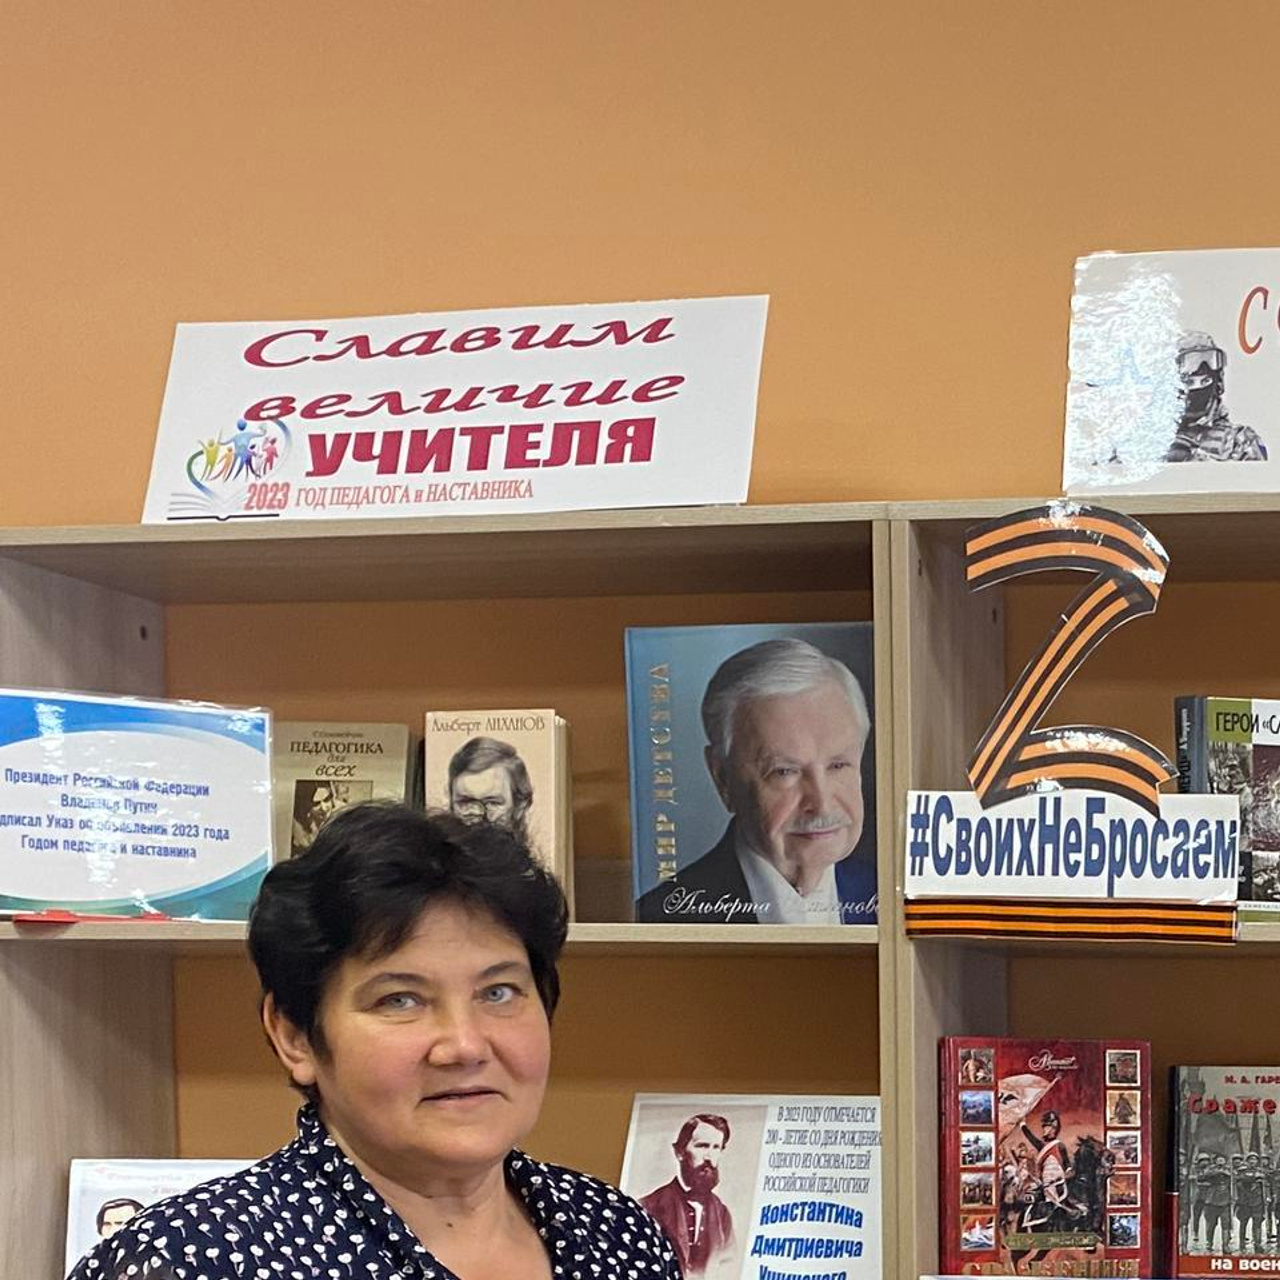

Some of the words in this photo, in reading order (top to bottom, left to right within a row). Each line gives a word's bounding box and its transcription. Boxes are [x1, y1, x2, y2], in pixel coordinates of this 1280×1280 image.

[1237, 286, 1269, 355] С
[244, 317, 675, 369] Славим
[244, 374, 685, 422] величие
[305, 417, 657, 478] УЧИТЕЛЯ
[244, 483, 289, 511] 2023
[295, 487, 327, 508] ГОД
[329, 484, 410, 505] ПЕДАГОГА
[414, 489, 425, 502] и
[427, 479, 534, 501] НАСТАВНИКА
[432, 715, 481, 736] Альберт
[485, 715, 546, 732] ЛИХАНОВ
[1216, 711, 1259, 733] ГЕРОИ
[290, 741, 384, 755] ПЕДАГОГИКА
[5, 768, 67, 786] Президент
[315, 765, 357, 777] всех
[0, 814, 41, 828] дписал
[46, 814, 73, 829] Указ
[172, 823, 199, 838] 2023
[204, 827, 230, 842] года
[21, 834, 58, 850] Годом
[132, 843, 197, 858] наставника
[910, 794, 1237, 898] #СвоихНеБросаем
[662, 887, 771, 921] Альберта
[801, 1106, 823, 1126] ГОДУ
[823, 1106, 876, 1123] ОТМЕЧАЕТСЯ
[812, 1150, 872, 1170] ОСНОВАТЕЛЕЙ
[760, 1201, 864, 1229] Константина
[751, 1235, 864, 1261] Дмитриевича
[1211, 1259, 1233, 1271] на
